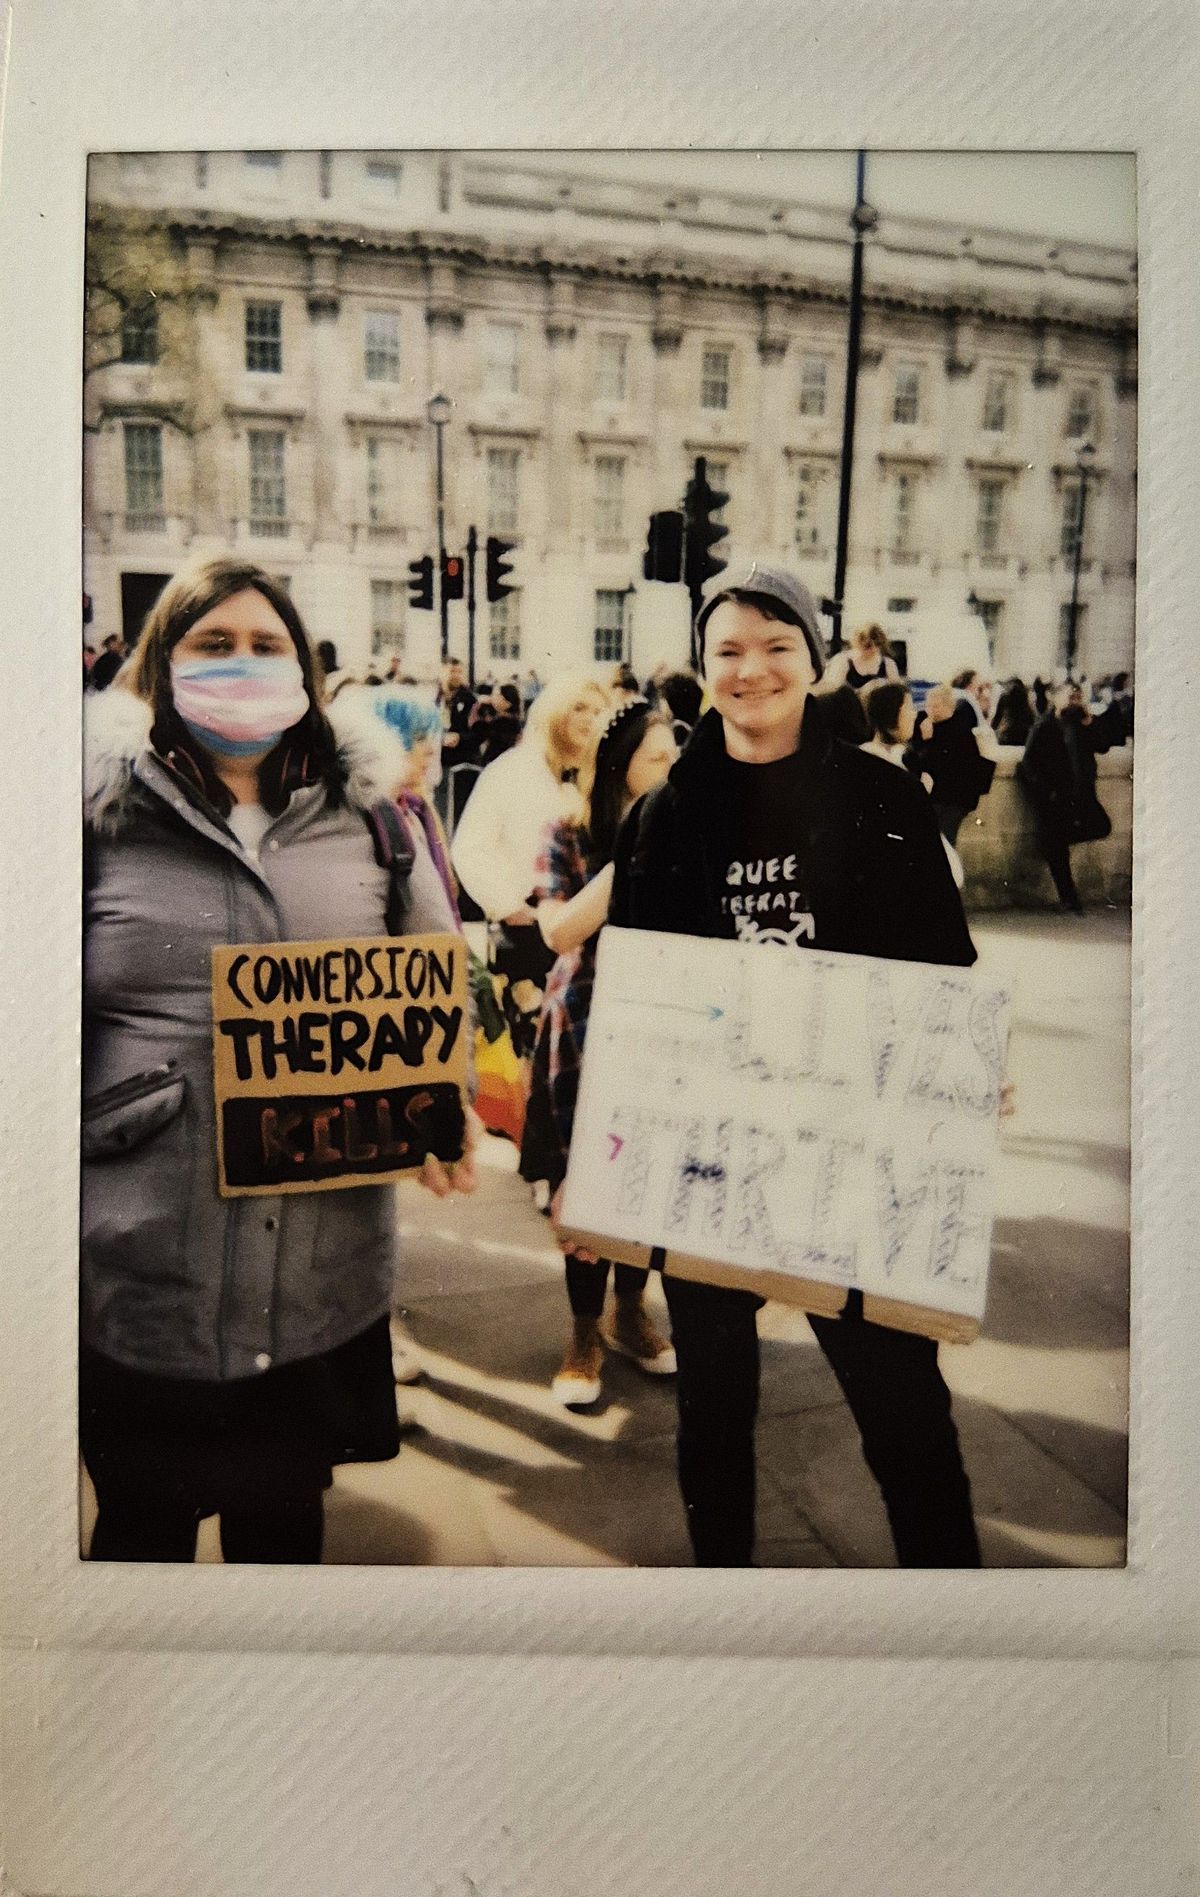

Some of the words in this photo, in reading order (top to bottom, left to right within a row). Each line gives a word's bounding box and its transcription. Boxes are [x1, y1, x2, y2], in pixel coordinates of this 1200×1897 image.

[726, 854, 798, 885] QUEE
[227, 947, 454, 1008] CONVERSION
[219, 1005, 463, 1081] THERAPY
[260, 1090, 435, 1164] KILLS
